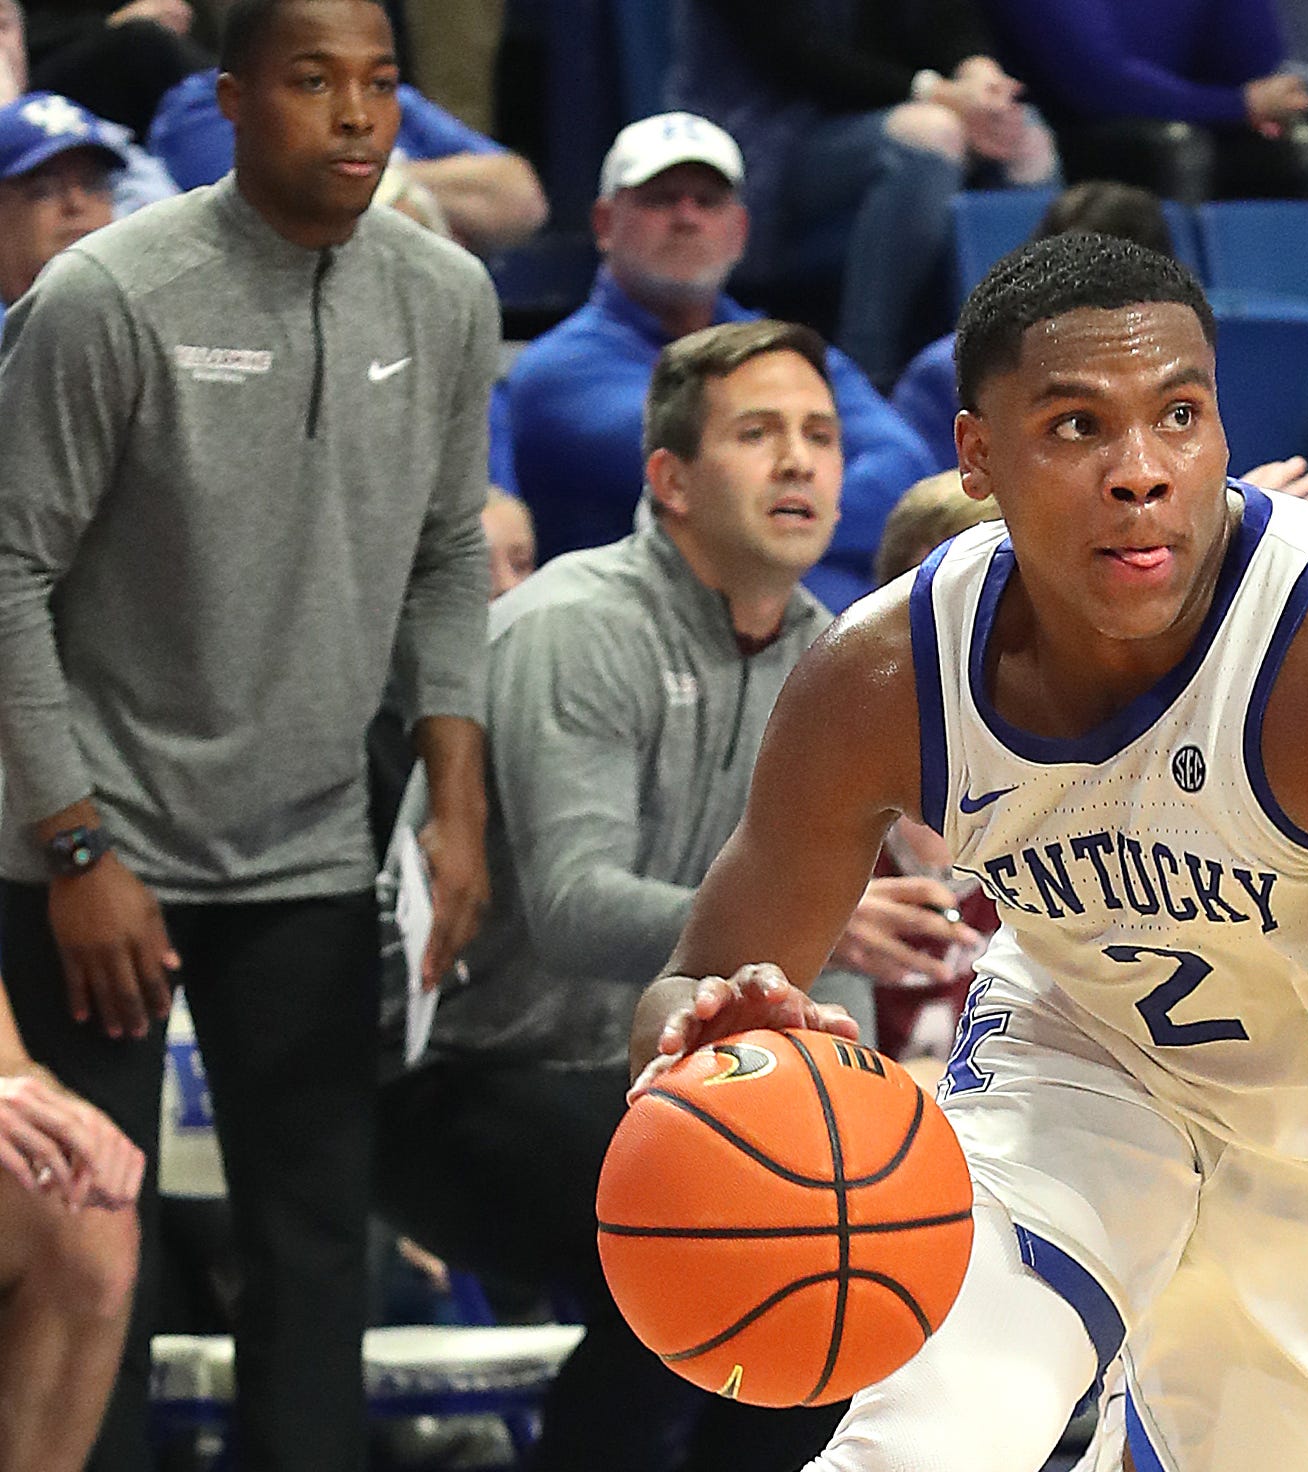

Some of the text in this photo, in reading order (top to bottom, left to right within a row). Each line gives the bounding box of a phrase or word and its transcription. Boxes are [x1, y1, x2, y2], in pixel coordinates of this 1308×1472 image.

[1174, 748, 1204, 790] SEC
[980, 832, 1279, 935] ENTUCKY
[1101, 945, 1250, 1047] 2
